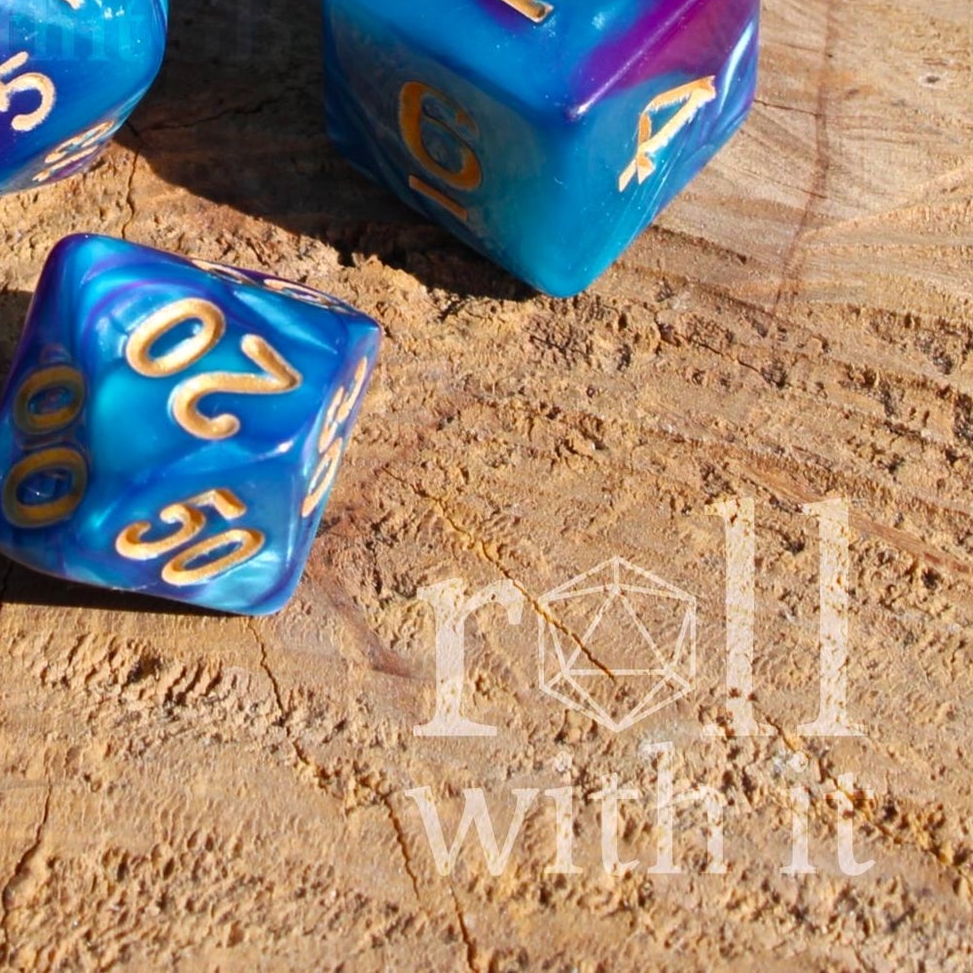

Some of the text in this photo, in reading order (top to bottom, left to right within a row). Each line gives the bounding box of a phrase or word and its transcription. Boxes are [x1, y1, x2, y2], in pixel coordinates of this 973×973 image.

[618, 75, 717, 192] 4
[127, 298, 303, 440] 20
[1, 365, 87, 528] 00
[116, 489, 265, 586] 50
